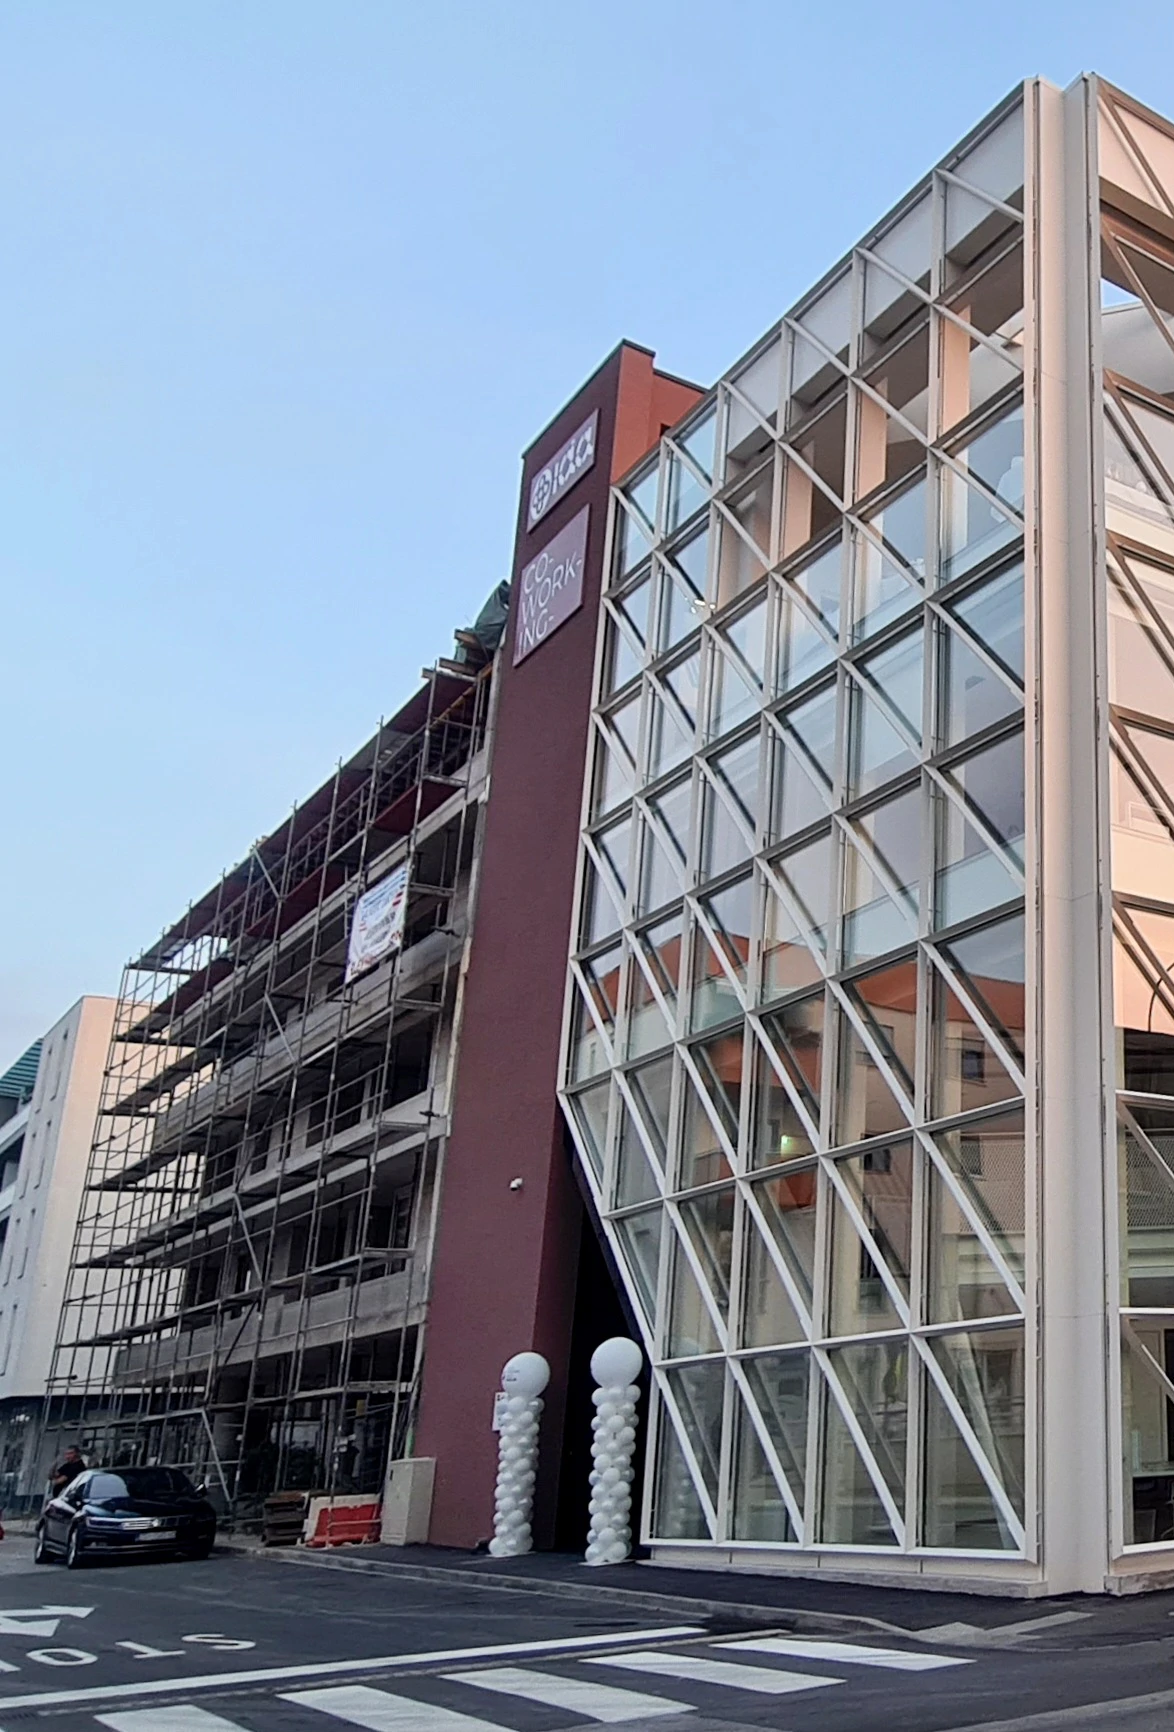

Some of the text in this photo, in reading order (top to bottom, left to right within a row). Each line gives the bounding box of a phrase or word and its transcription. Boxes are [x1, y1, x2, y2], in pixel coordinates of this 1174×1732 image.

[521, 551, 582, 625] WORK-
[524, 552, 554, 595] CO-
[518, 608, 554, 658] ING-
[0, 1633, 256, 1672] STO
